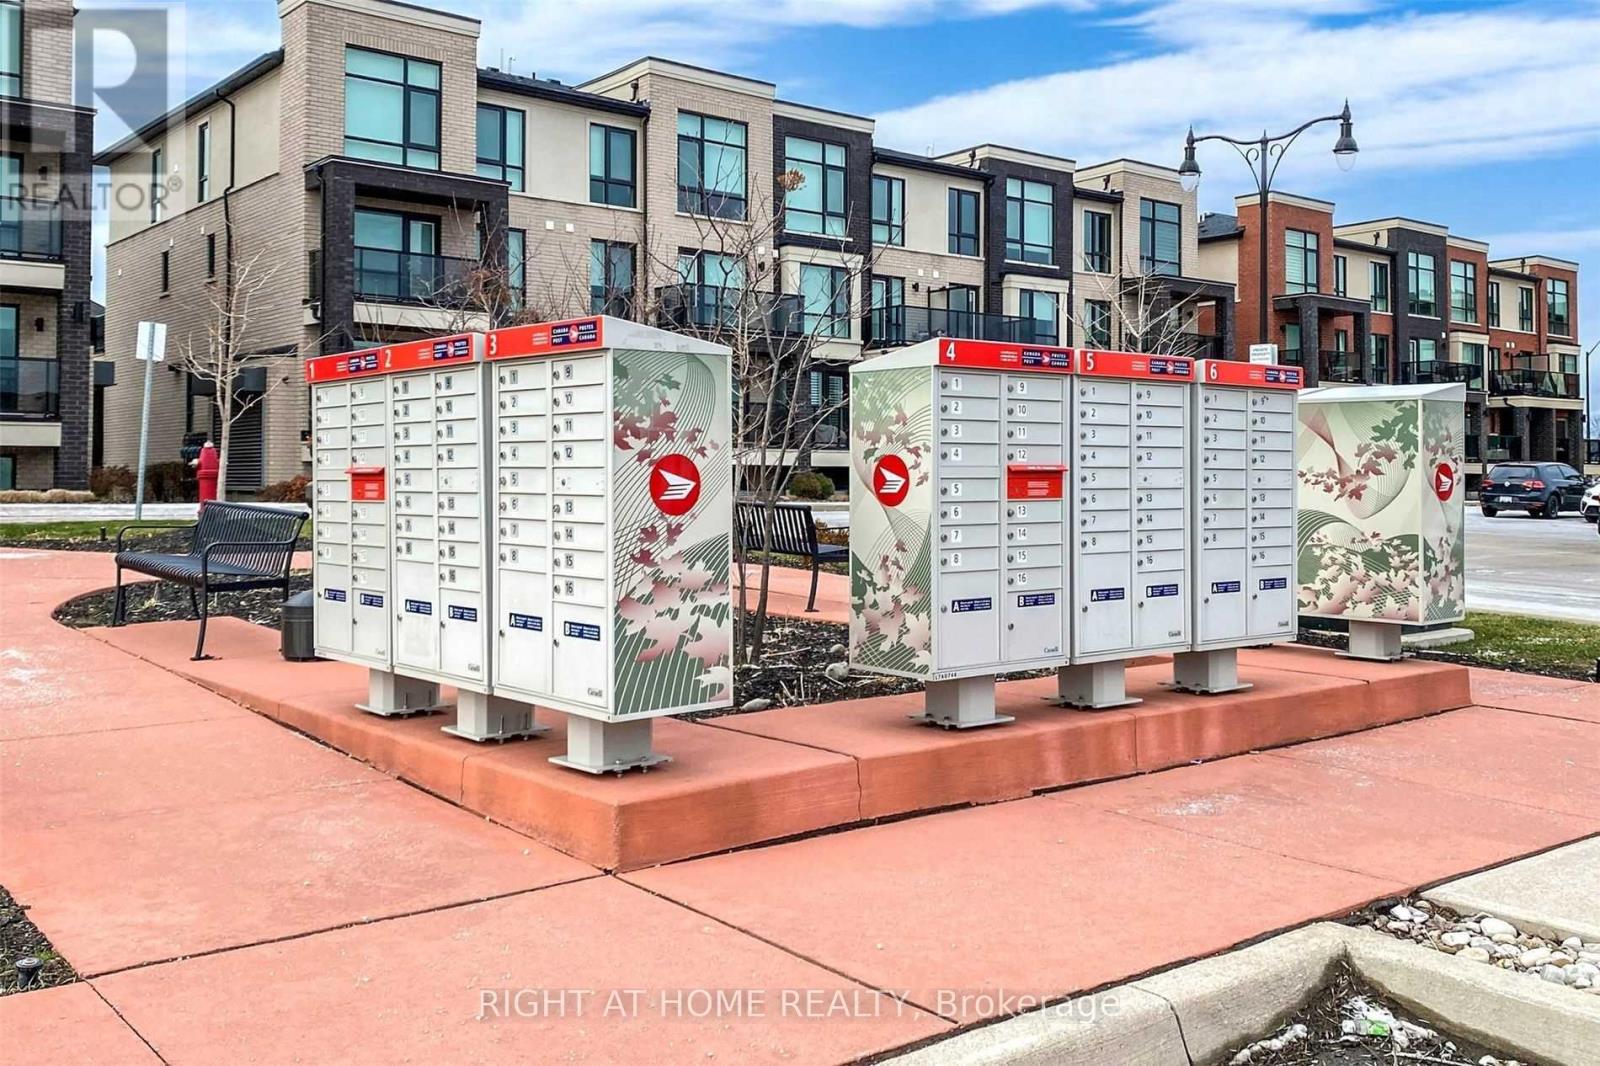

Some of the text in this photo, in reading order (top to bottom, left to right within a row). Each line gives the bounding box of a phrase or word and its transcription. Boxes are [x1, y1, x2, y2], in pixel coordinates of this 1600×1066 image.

[489, 334, 497, 355] 3
[946, 342, 956, 361] 4
[384, 349, 392, 368] 2
[1086, 352, 1095, 371] 5
[309, 361, 315, 379] 1
[566, 367, 570, 377] 9
[1210, 363, 1218, 380] 6
[1020, 382, 1024, 392] 9
[1146, 391, 1151, 399] 9
[512, 397, 516, 408] 2
[954, 402, 958, 411] 2
[1018, 405, 1026, 415] 10
[1091, 408, 1096, 417] 2
[1146, 411, 1152, 419] 10
[512, 423, 516, 432] 3
[566, 420, 572, 431] 11
[954, 425, 959, 435] 3
[1018, 428, 1026, 437] 11
[1091, 430, 1096, 438] 3
[1146, 432, 1152, 440] 11
[1214, 434, 1217, 442] 3
[512, 448, 516, 457] 4
[566, 447, 572, 458] 12
[954, 449, 959, 457] 4
[1018, 450, 1026, 459] 12
[1146, 452, 1152, 460] 12
[512, 474, 516, 484] 5
[1092, 473, 1096, 481] 5
[1213, 474, 1217, 482] 5
[954, 484, 959, 493] 5
[1092, 494, 1096, 503] 6
[1146, 494, 1152, 502] 13
[512, 499, 516, 509] 6
[566, 502, 572, 512] 13
[954, 507, 959, 516] 6
[1018, 506, 1026, 515] 13
[1092, 516, 1096, 524] 7
[1146, 514, 1152, 522] 14
[512, 525, 516, 534] 7
[566, 529, 572, 539] 14
[1018, 528, 1026, 537] 14
[954, 531, 959, 540] 7
[1147, 535, 1152, 543] 15
[1260, 532, 1265, 540] 15
[1092, 537, 1096, 546] 8
[512, 551, 516, 560] 8
[954, 554, 959, 563] 8
[1018, 551, 1026, 560] 15
[1147, 556, 1153, 564] 16
[566, 556, 573, 566] 15
[1018, 574, 1026, 582] 16
[566, 583, 573, 593] 16
[1212, 584, 1218, 593] A
[1261, 580, 1264, 589] B
[1092, 591, 1098, 600] A
[1148, 587, 1152, 597] B
[406, 601, 410, 611] A
[1020, 597, 1024, 606] B
[953, 602, 959, 611] A
[511, 615, 515, 626] A
[566, 623, 570, 634] B
